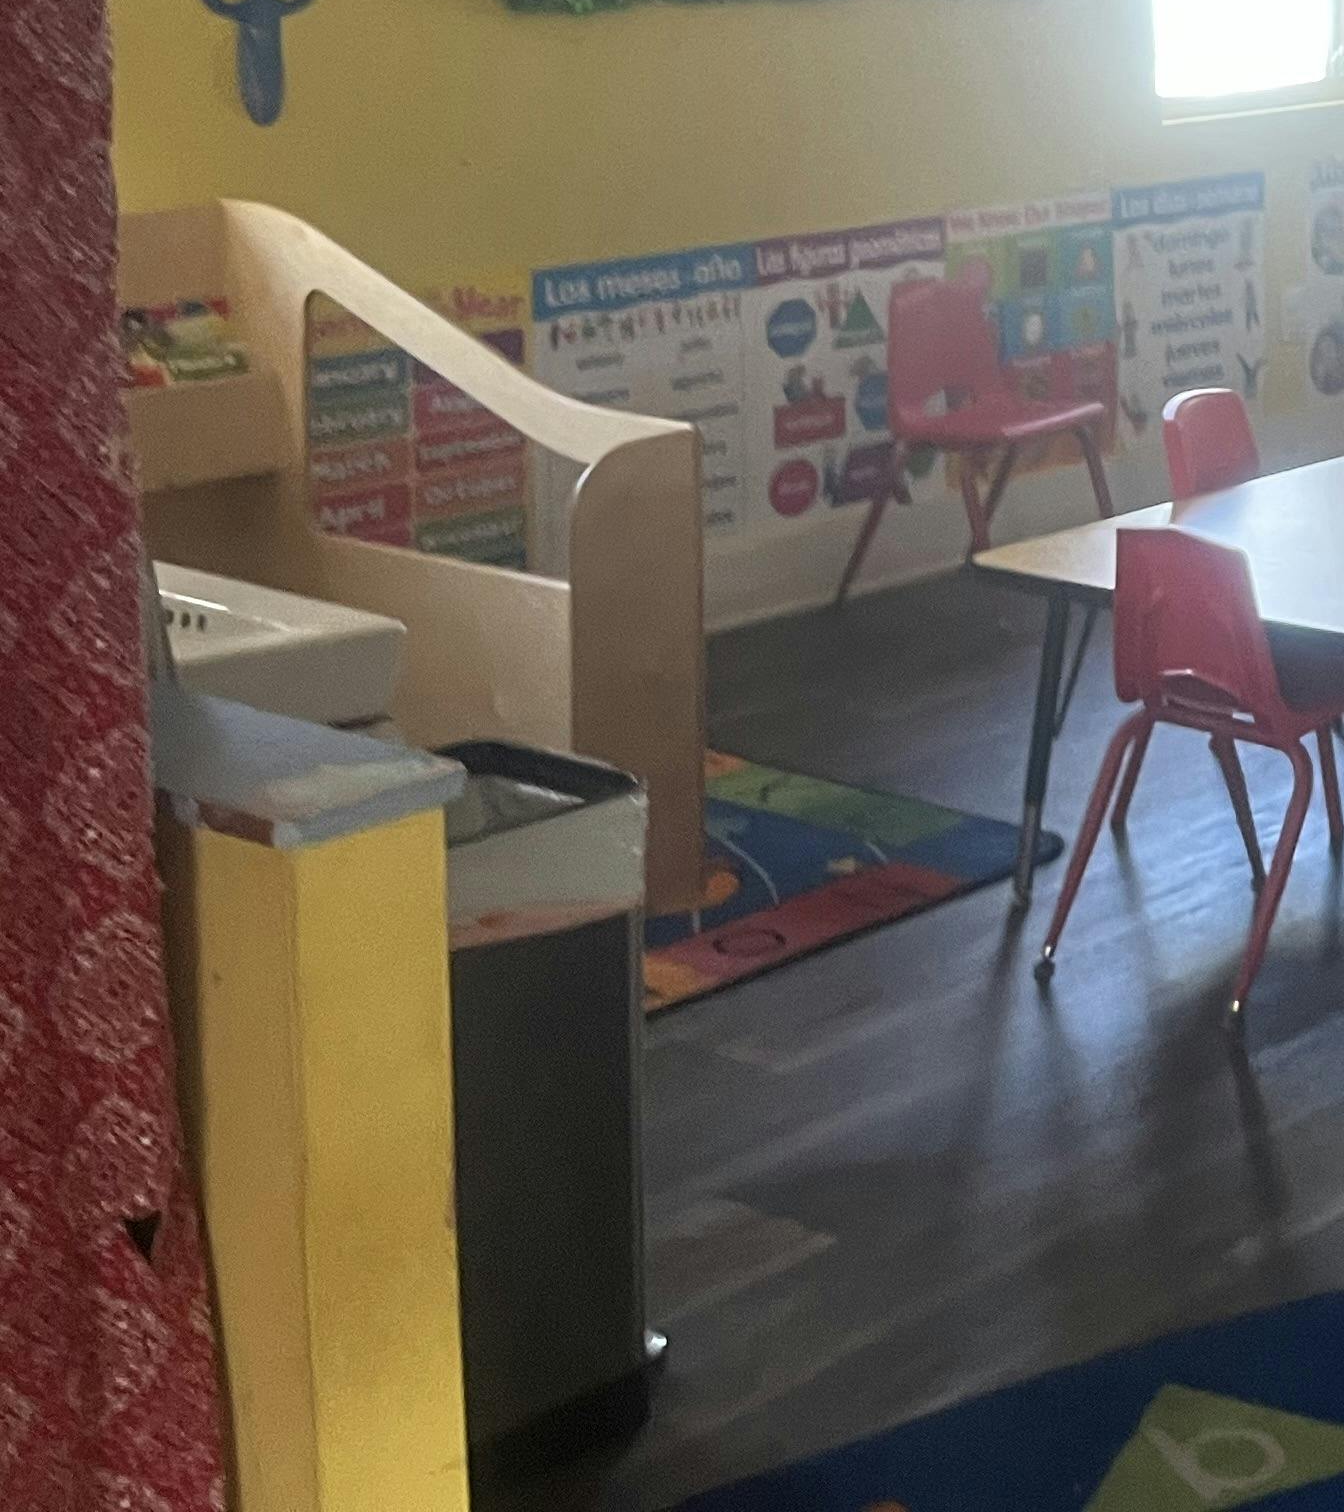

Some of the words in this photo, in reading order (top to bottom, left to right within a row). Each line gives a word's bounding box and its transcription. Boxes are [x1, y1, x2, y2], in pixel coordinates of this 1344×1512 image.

[545, 278, 590, 308] Los
[597, 267, 682, 300] meses
[692, 253, 743, 285] año
[312, 362, 398, 387] anuary
[1147, 1427, 1286, 1501] b
